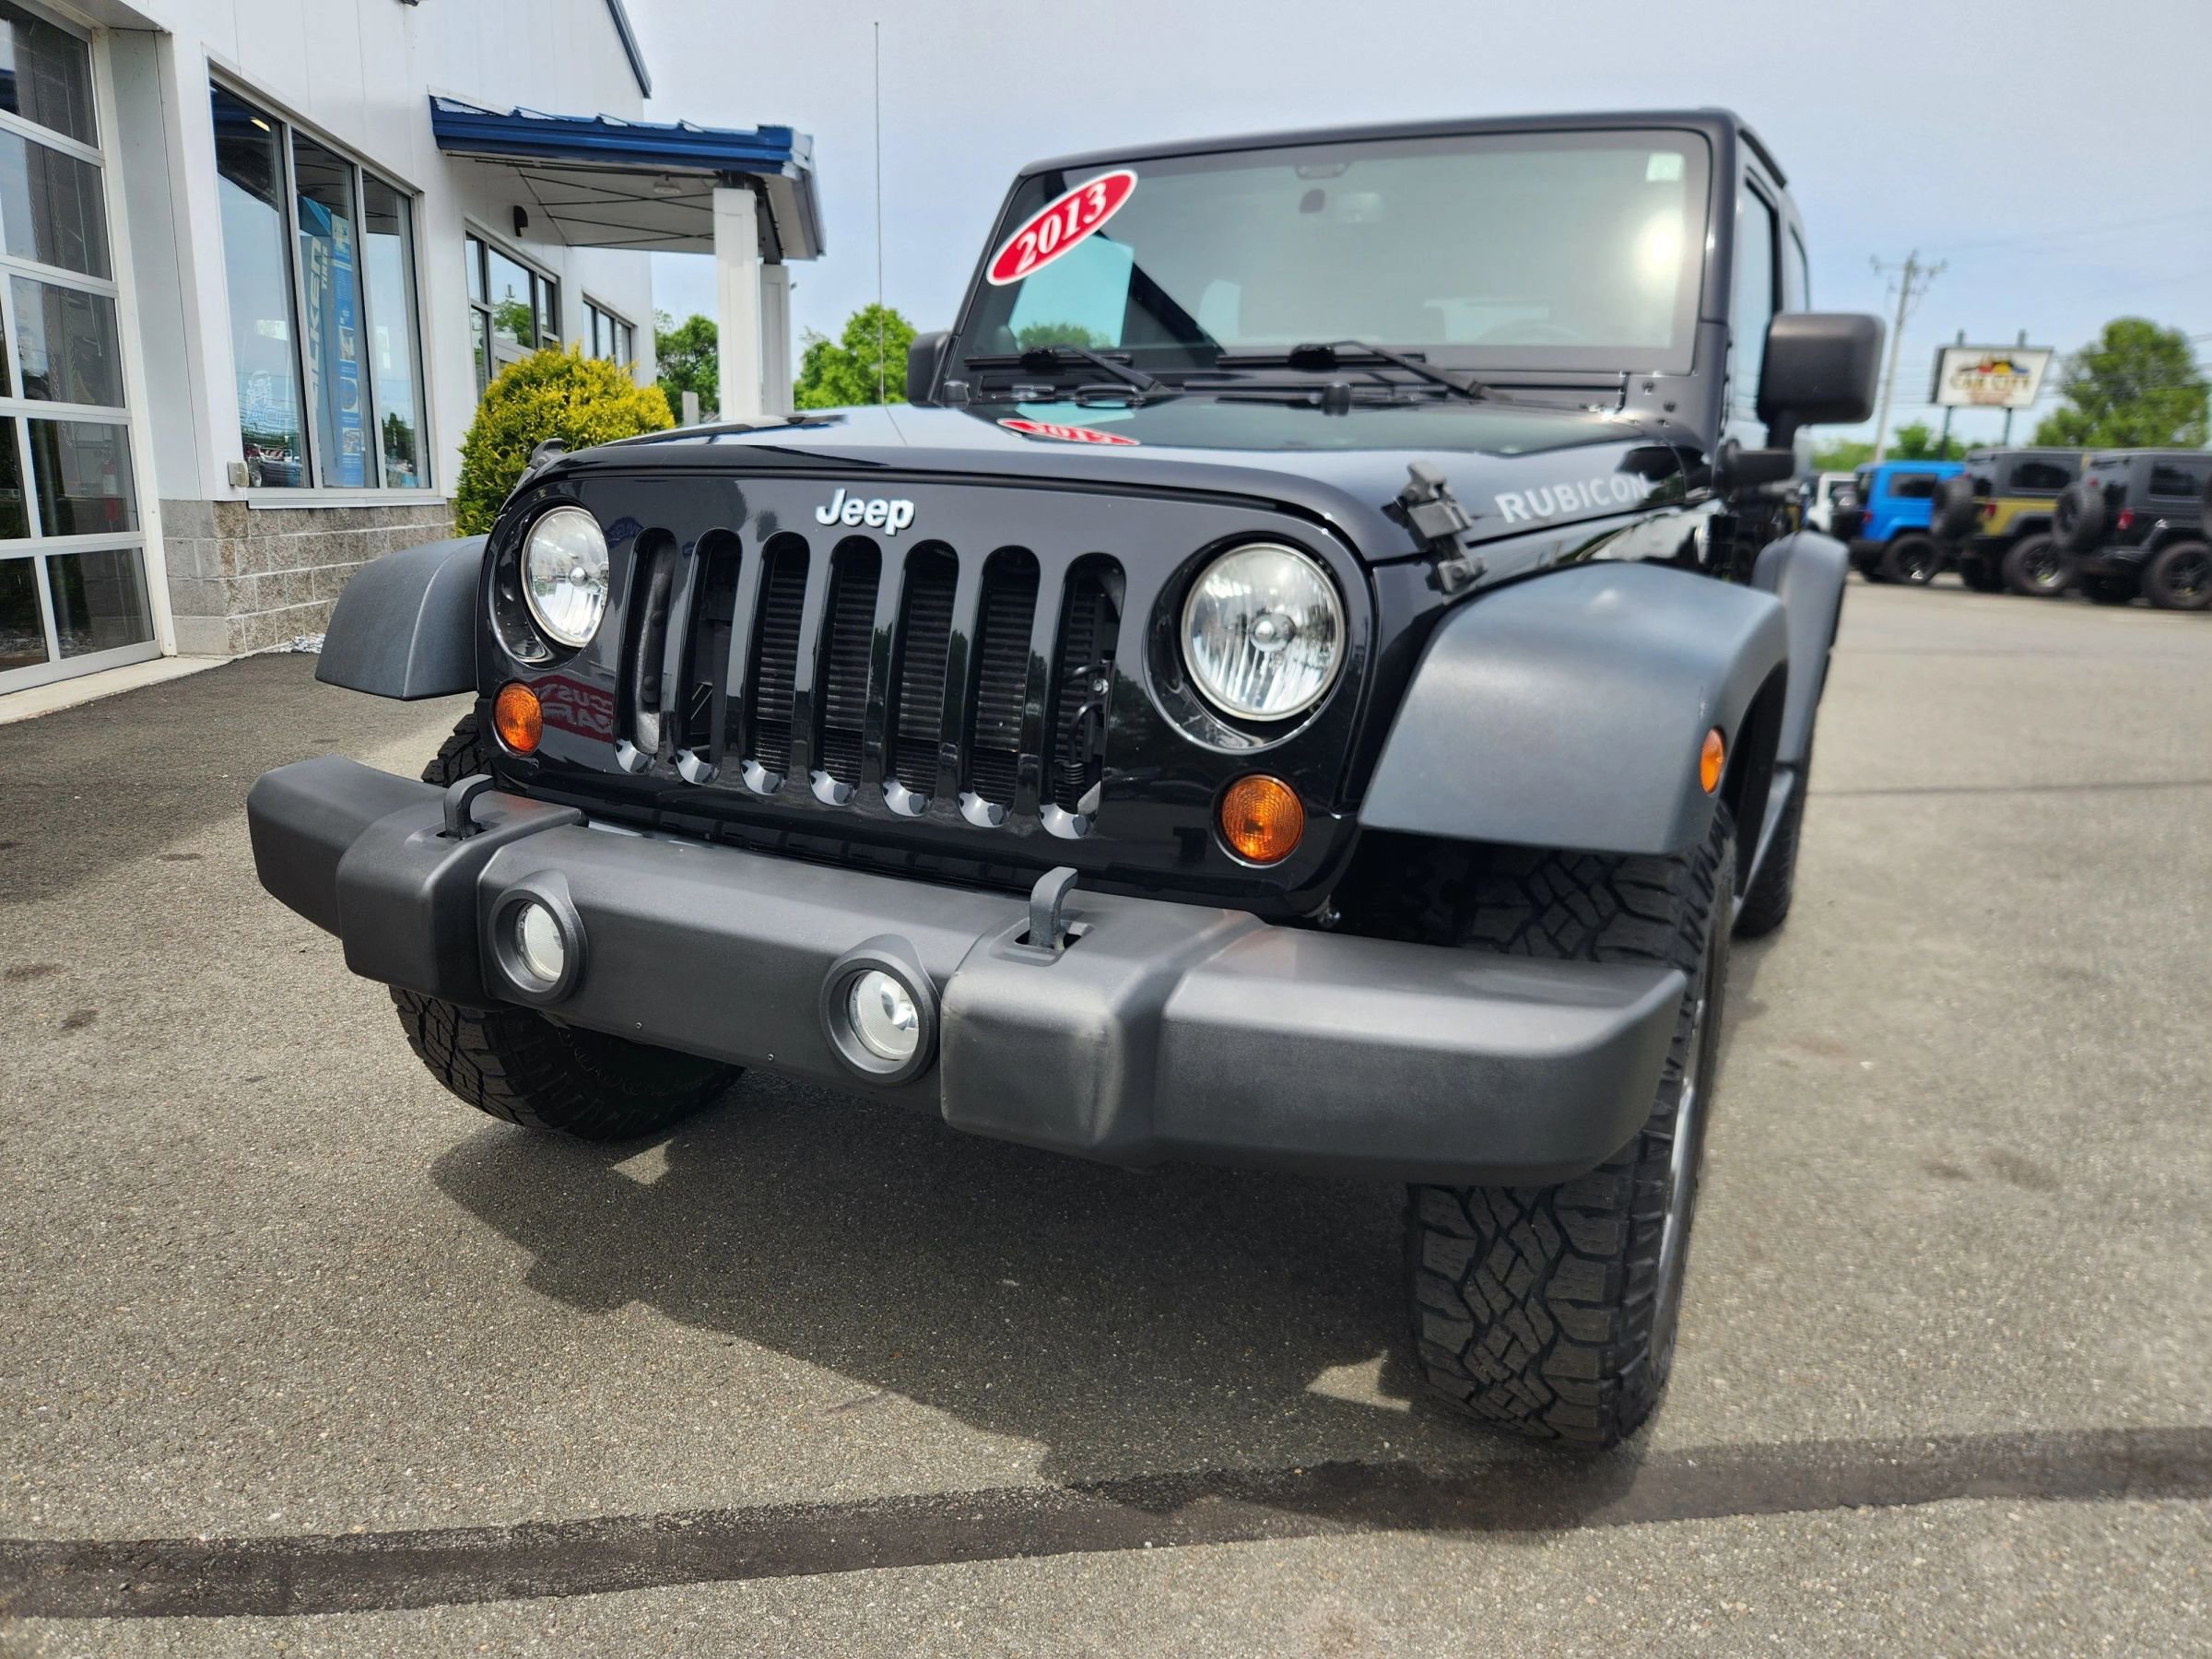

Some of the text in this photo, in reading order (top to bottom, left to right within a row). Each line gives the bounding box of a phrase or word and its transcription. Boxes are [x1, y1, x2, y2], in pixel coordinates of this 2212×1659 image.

[1015, 182, 1107, 275] 2013
[815, 488, 915, 536] Jeep
[1494, 472, 1650, 524] RUBICON
